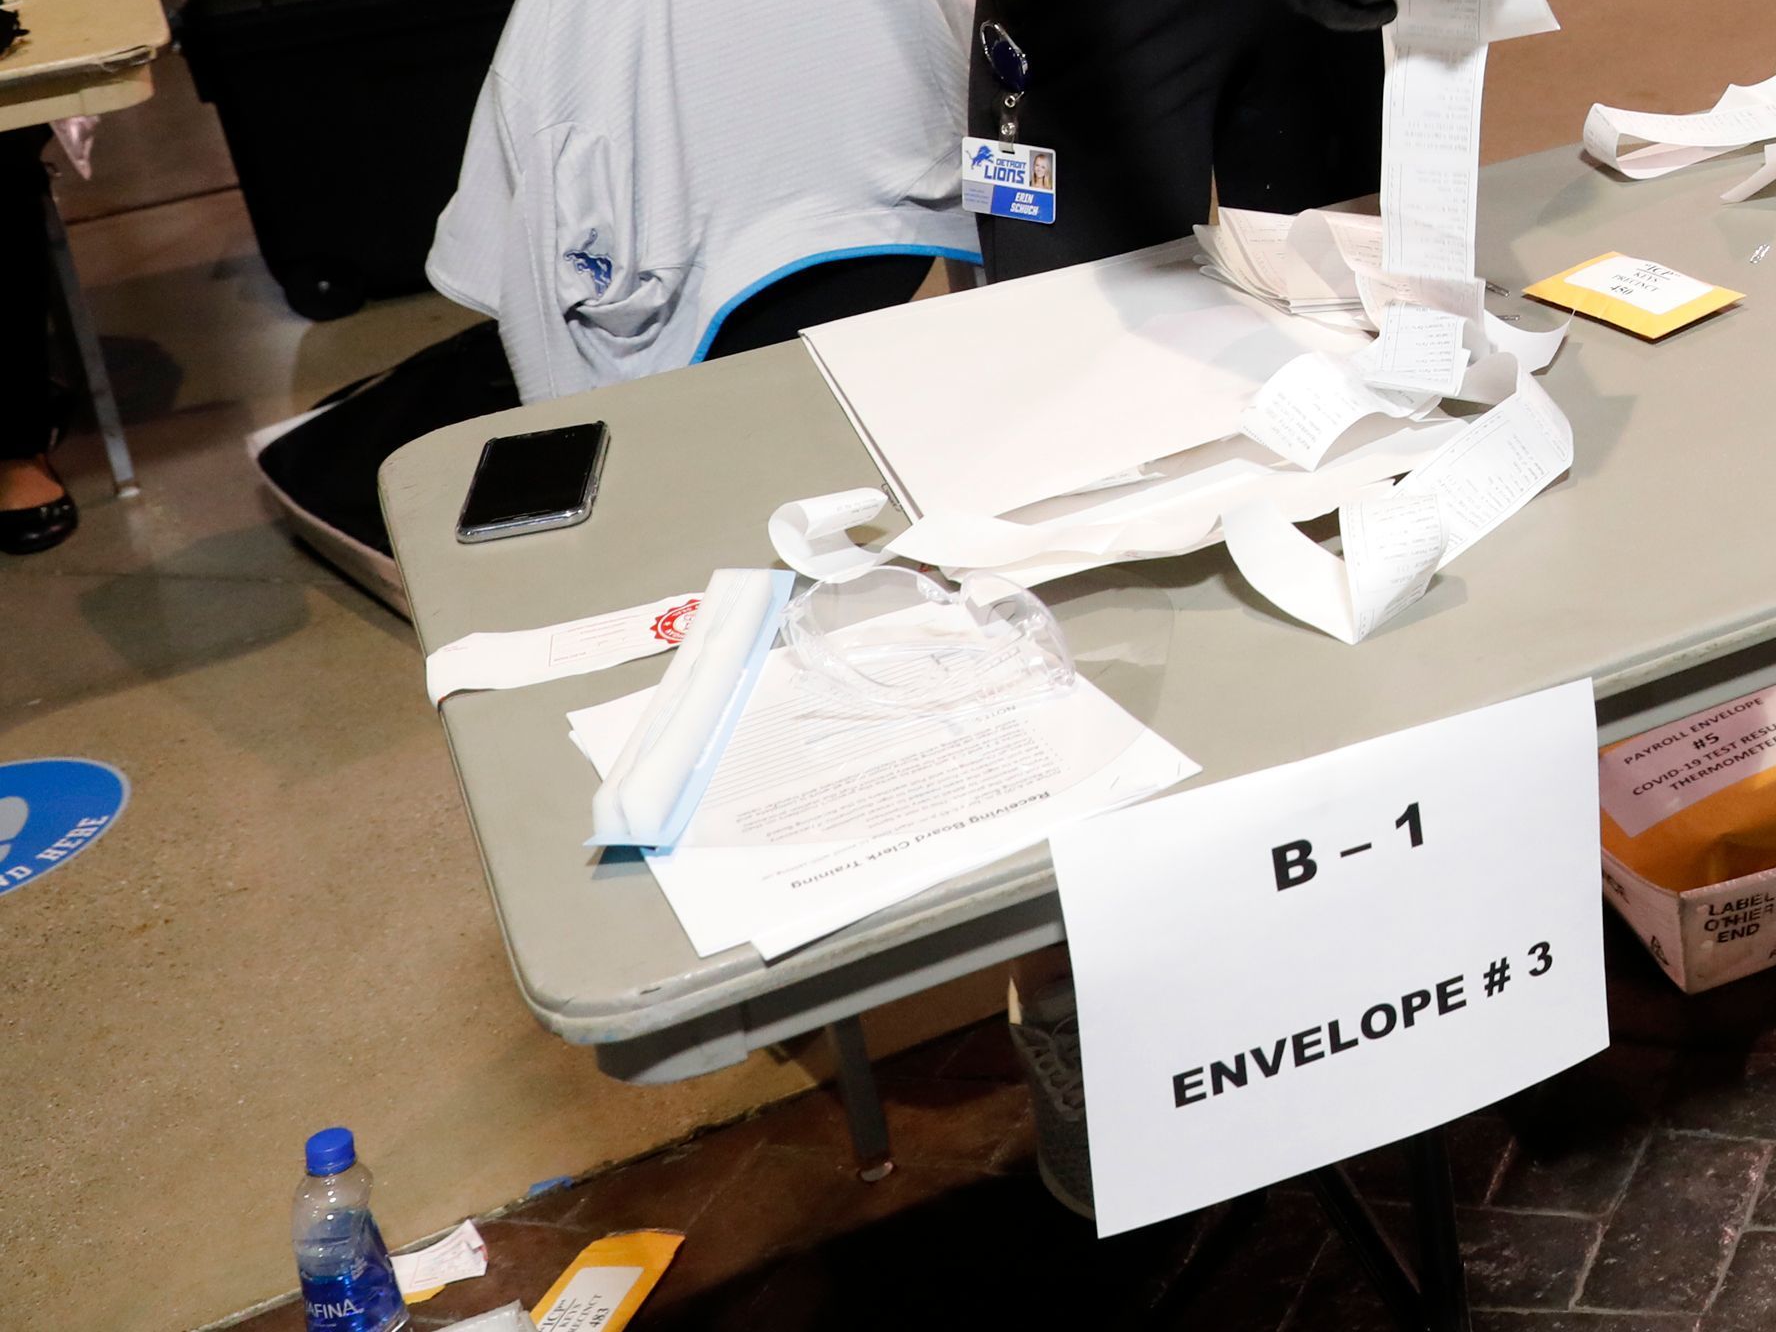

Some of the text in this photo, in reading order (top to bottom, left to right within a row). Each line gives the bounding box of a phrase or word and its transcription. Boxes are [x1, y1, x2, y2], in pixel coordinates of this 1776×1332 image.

[984, 165, 1025, 184] LIONS
[996, 158, 1027, 169] DETROIT
[1015, 192, 1034, 204] ERIN
[1612, 274, 1660, 292] PRECINCT
[1624, 698, 1765, 765] PAYROLL ENVELOPE
[1693, 732, 1720, 751] #5
[1632, 758, 1702, 796] COVID-19
[1706, 744, 1739, 761] TEST
[35, 815, 110, 861] HERE
[790, 790, 1050, 890] Receiving Board Clerk Training
[1272, 840, 1317, 891] B
[1396, 803, 1423, 847] 1
[1708, 891, 1776, 916] LABEL
[1704, 903, 1775, 933] OTHER
[1717, 923, 1761, 943] END
[1173, 942, 1552, 1107] ENVELOPE # 3
[589, 1308, 609, 1328] 483
